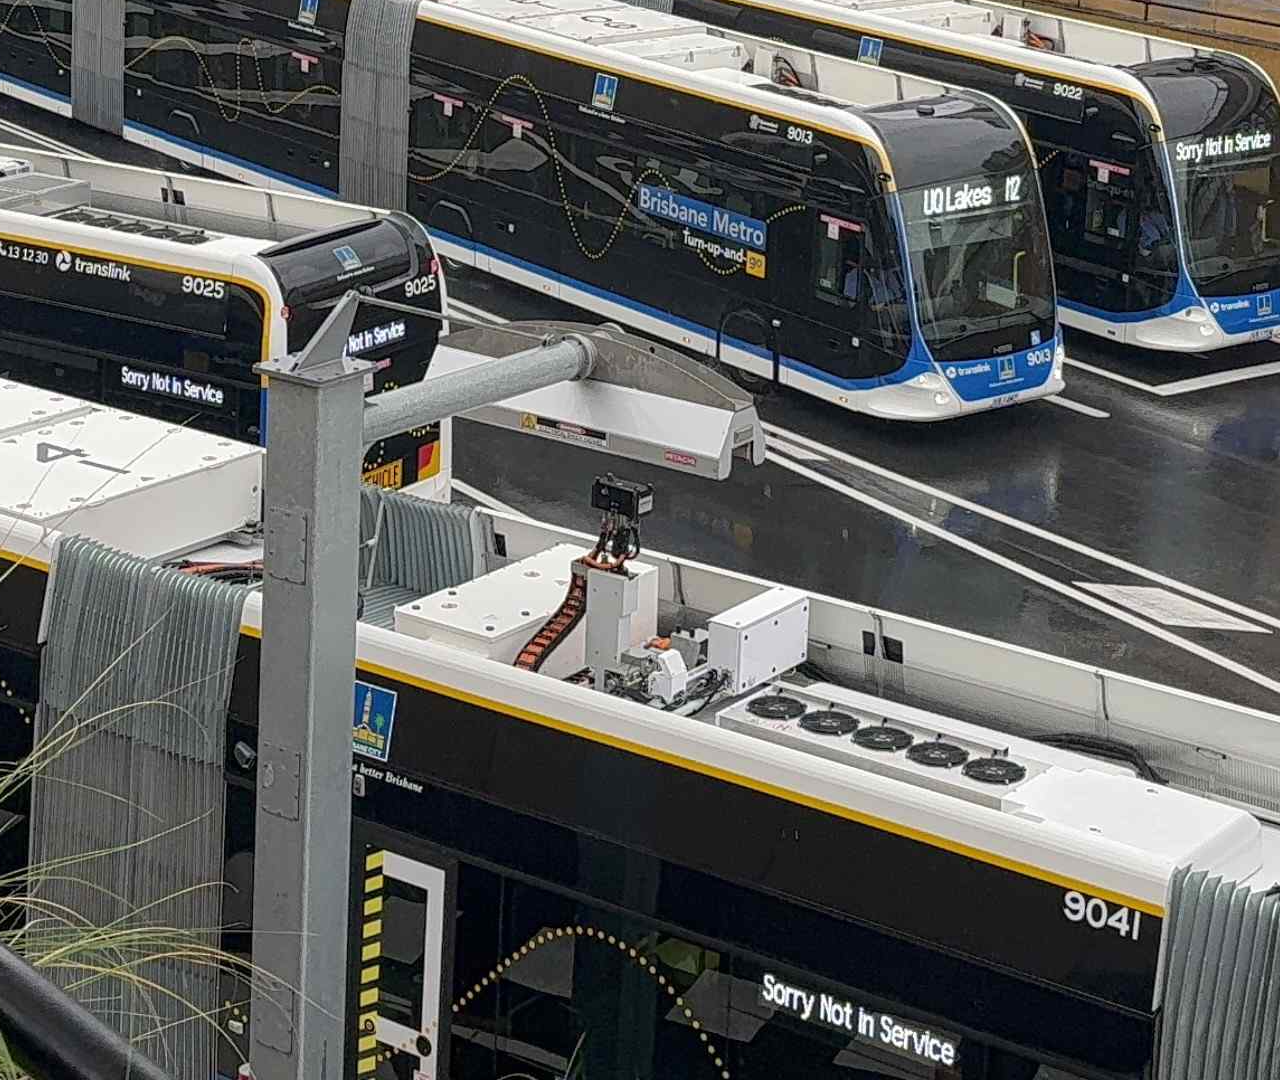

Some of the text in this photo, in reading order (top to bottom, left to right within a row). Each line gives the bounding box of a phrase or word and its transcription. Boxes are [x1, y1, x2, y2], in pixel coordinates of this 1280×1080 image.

[1053, 81, 1083, 100] 9022
[787, 126, 814, 145] 9013
[1176, 141, 1204, 162] Sorry
[1205, 136, 1223, 157] Not
[1235, 130, 1272, 152] Service
[945, 184, 992, 211] Lakes
[639, 187, 765, 246] Brisbane Metro
[7, 246, 20, 259] 13
[75, 258, 131, 282] translink
[182, 276, 225, 299] 9025
[405, 275, 436, 298] 9025
[348, 331, 364, 354] Not
[374, 322, 405, 346] Service
[1027, 348, 1051, 367] 9013
[958, 363, 992, 377] translink
[121, 366, 150, 391] Sorry
[151, 373, 172, 393] Not
[184, 379, 224, 405] Service
[665, 452, 696, 466] HITACHI
[360, 762, 385, 780] better
[385, 770, 424, 794] Brisbane
[1063, 890, 1141, 941] 9041
[762, 973, 815, 1021] Sorry
[820, 993, 853, 1031] Not
[880, 1015, 956, 1066] Service
